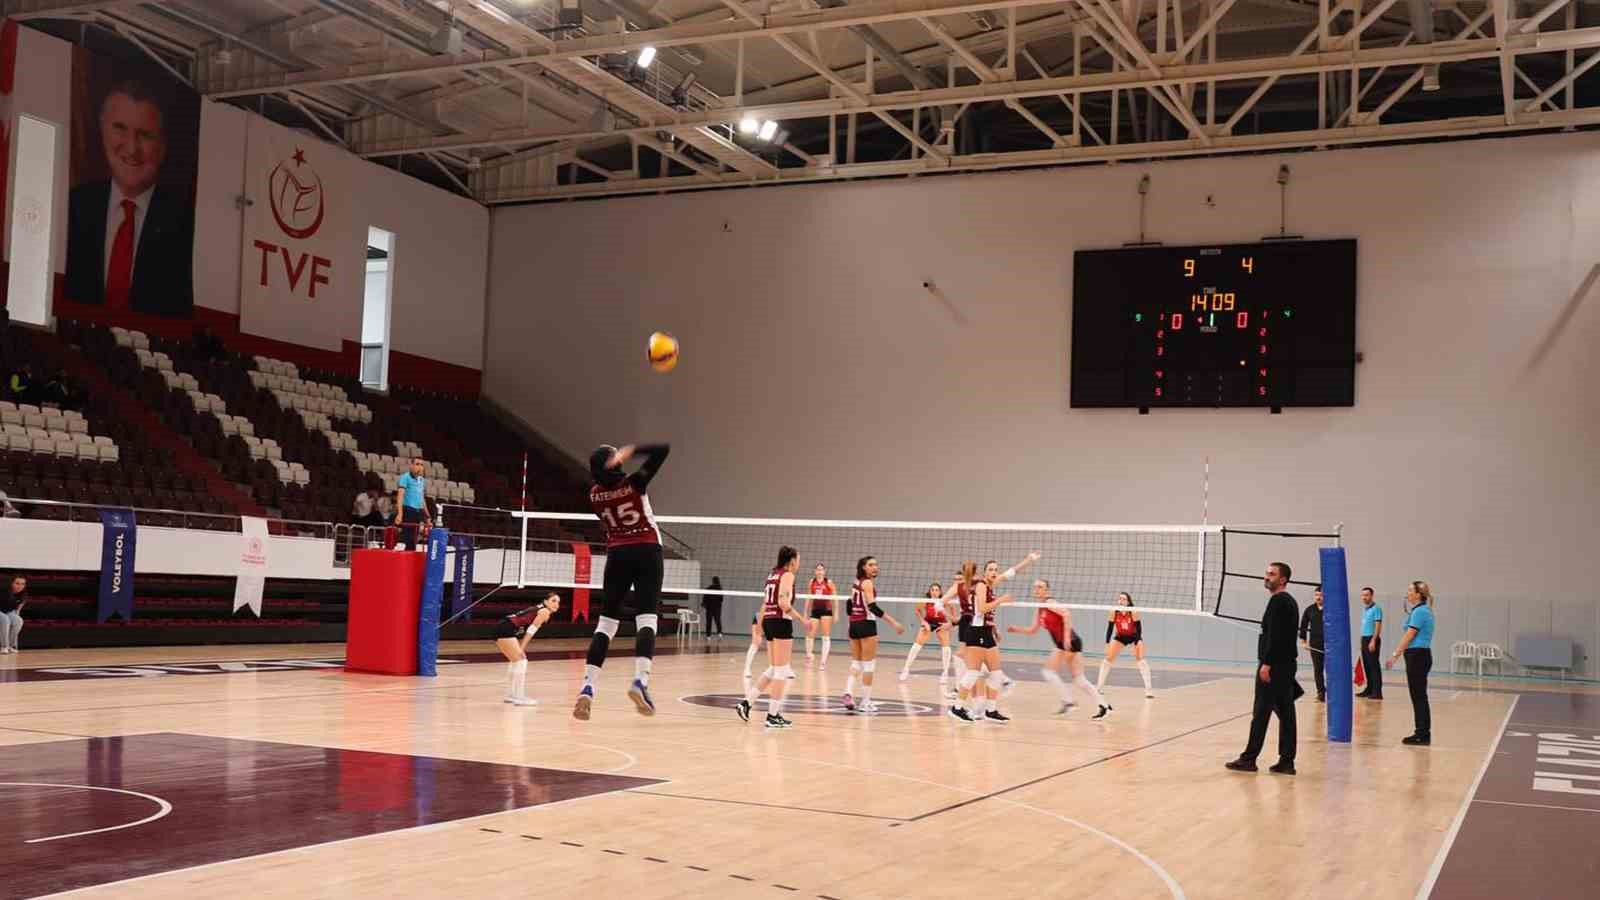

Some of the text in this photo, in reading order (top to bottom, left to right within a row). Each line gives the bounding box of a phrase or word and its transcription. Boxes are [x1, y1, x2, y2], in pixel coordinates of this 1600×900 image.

[254, 239, 332, 298] TVF
[1184, 259, 1195, 277] 9
[1242, 257, 1253, 274] 4
[1172, 313, 1183, 329] 0
[1237, 312, 1248, 328] 0
[601, 502, 640, 529] 15
[112, 533, 124, 593] VOLEYBOL
[764, 583, 776, 604] 17
